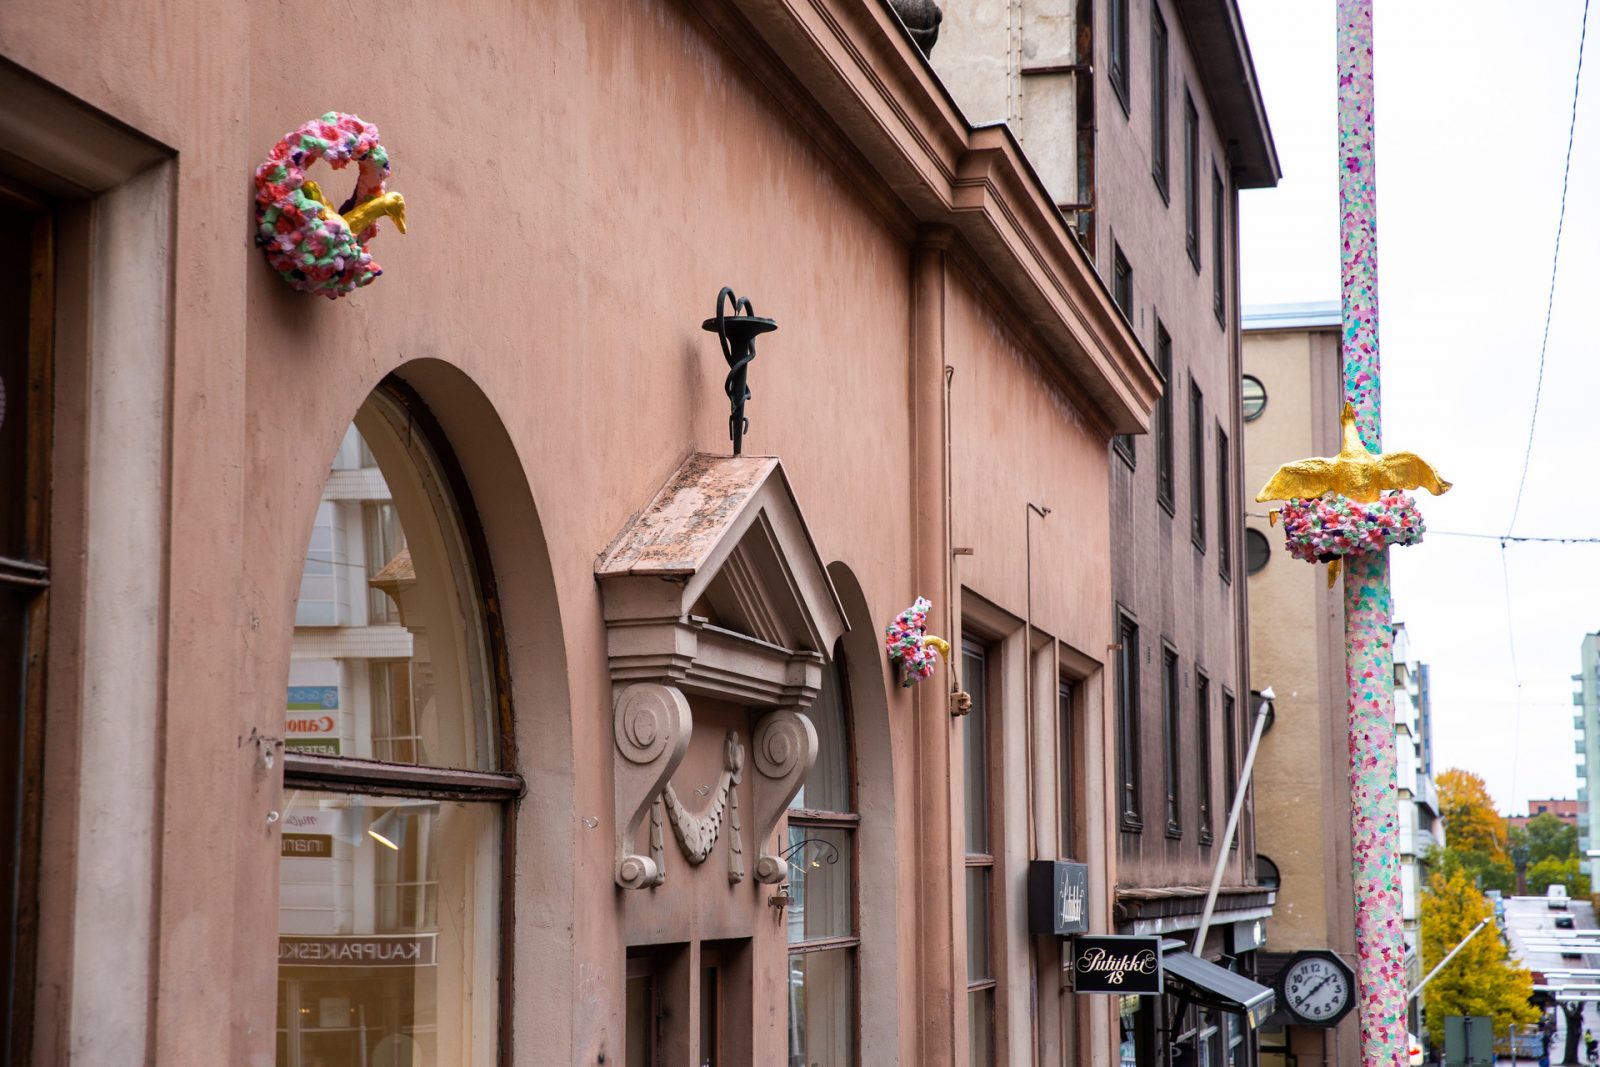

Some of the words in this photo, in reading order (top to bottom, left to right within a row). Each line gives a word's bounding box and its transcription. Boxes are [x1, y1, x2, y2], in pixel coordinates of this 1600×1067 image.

[1076, 947, 1158, 975] Putiikki
[1301, 966, 1308, 975] 11
[1311, 963, 1320, 972] 12
[1104, 970, 1125, 985] 18
[1293, 974, 1302, 983] 10
[1291, 985, 1298, 993] 9
[1335, 985, 1341, 993] 3
[1304, 1004, 1310, 1012] 7
[1314, 1007, 1321, 1015] 6
[1325, 1003, 1331, 1011] 5
